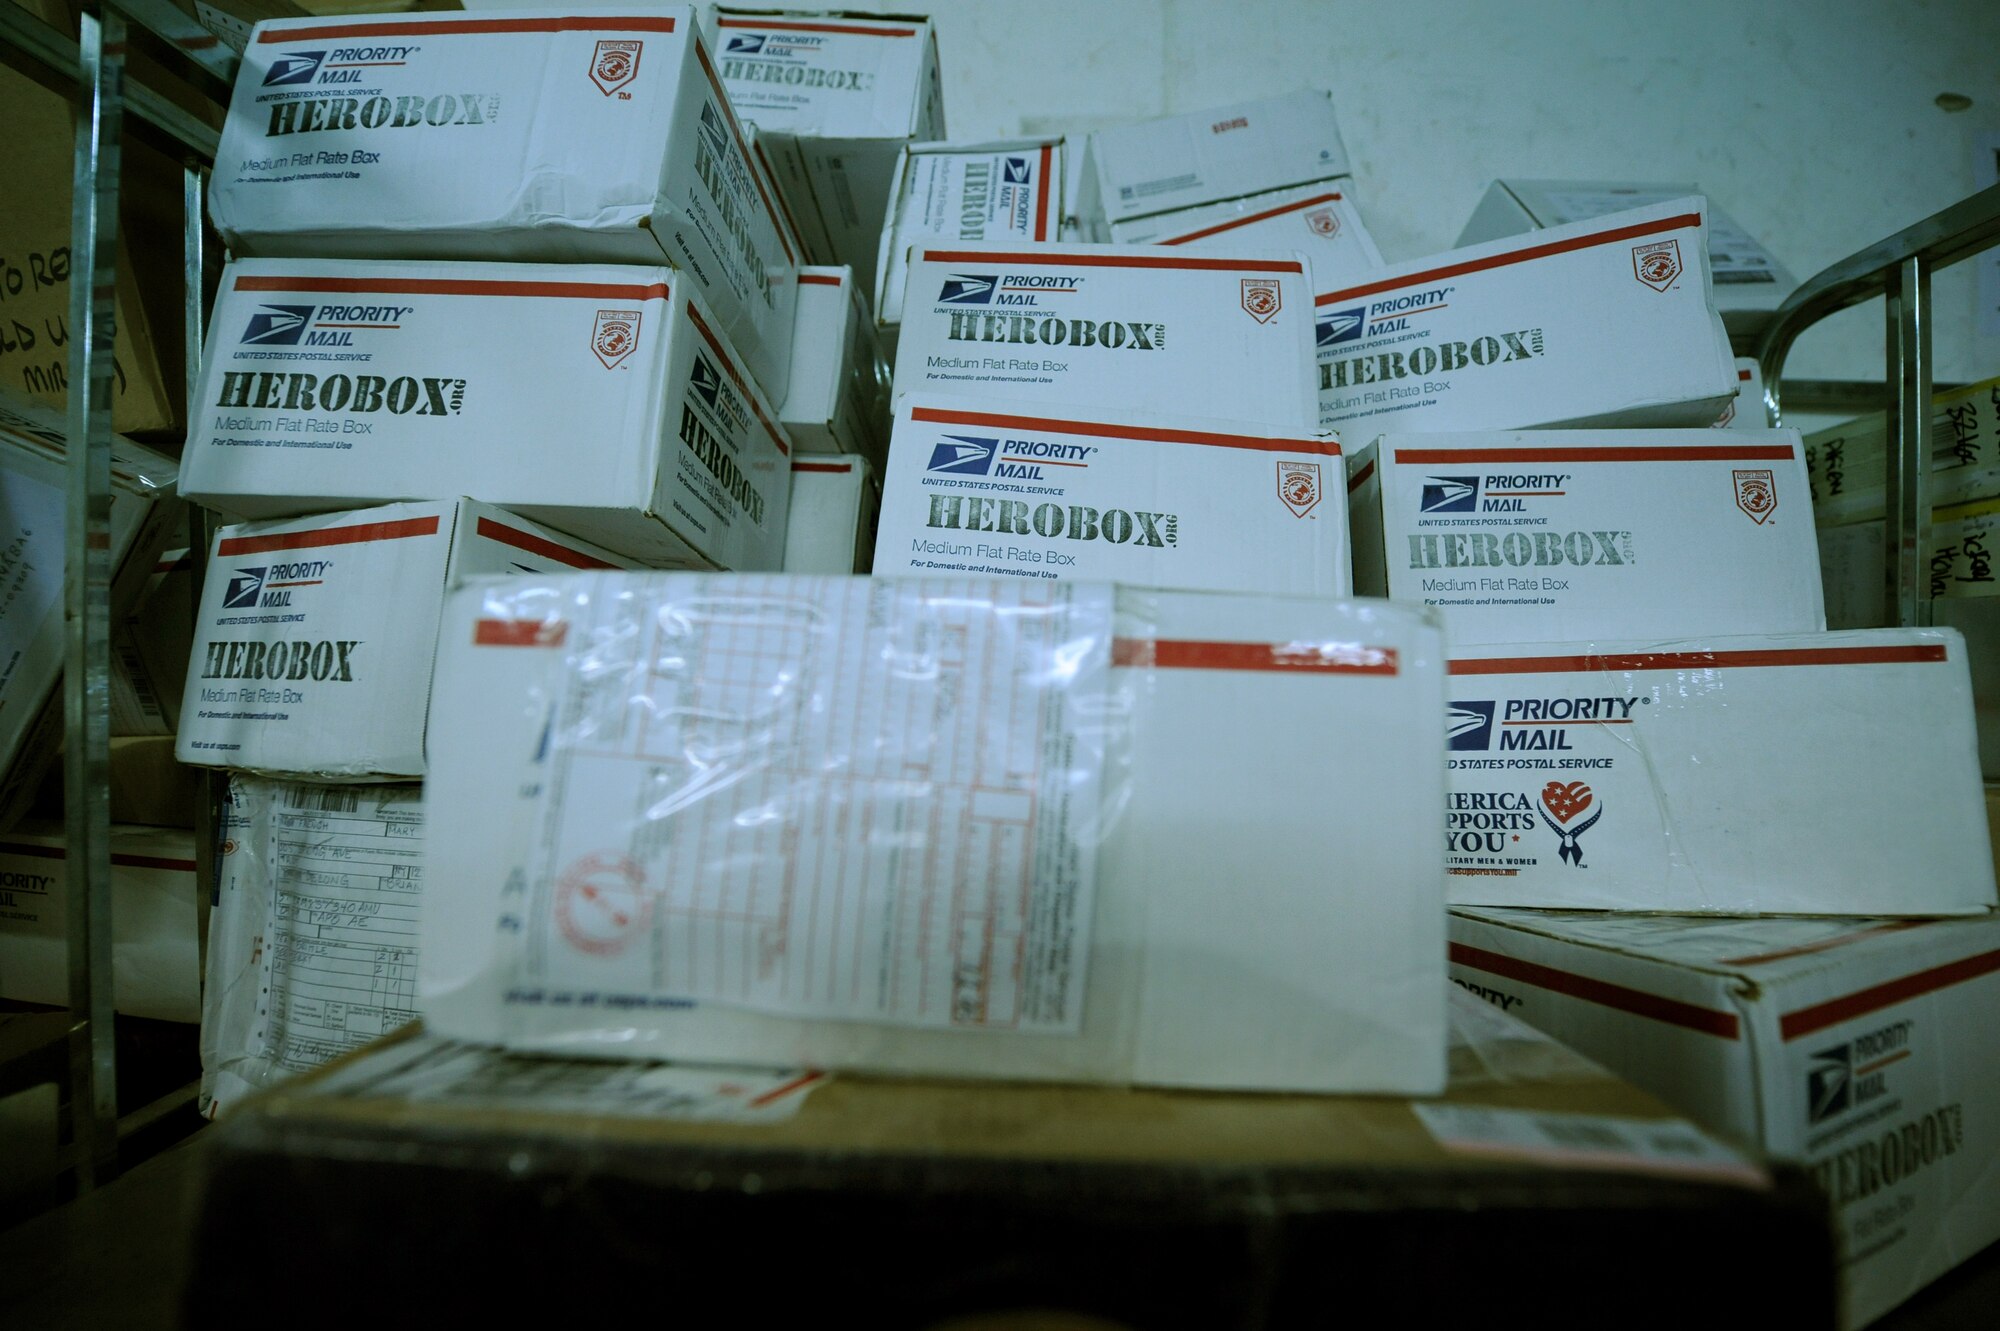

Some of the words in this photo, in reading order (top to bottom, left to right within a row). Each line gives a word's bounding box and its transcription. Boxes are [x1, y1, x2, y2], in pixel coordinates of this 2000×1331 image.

[769, 34, 823, 45] PRIORITY
[329, 46, 416, 61] PRIORITY
[763, 48, 793, 56] MAIL
[318, 70, 362, 84] MAIL
[723, 61, 864, 91] HEROBOX
[314, 90, 346, 98] POSTAL
[346, 88, 383, 96] SERVICE
[265, 93, 486, 137] HEROBOX
[240, 157, 287, 172] Medium
[291, 154, 314, 168] Flat
[317, 151, 348, 166] Rate
[351, 150, 380, 164] Box
[345, 171, 360, 179] Use
[960, 162, 990, 240] HEROB
[1000, 185, 1012, 209] MAIL
[1016, 186, 1030, 232] PRIORITY
[675, 231, 685, 245] Visit
[692, 257, 710, 288] usps.com
[1002, 275, 1079, 288] PRIORITY
[996, 294, 1039, 306] MAIL
[1371, 287, 1449, 316] PRIORITY
[316, 305, 407, 322] PRIORITY
[933, 307, 965, 315] UNITED
[965, 308, 992, 316] STATES
[947, 313, 1154, 350] HEROBOX
[1368, 318, 1411, 336] MAIL
[304, 331, 354, 346] MAIL
[1154, 324, 1166, 350] .ORG
[1339, 344, 1366, 354] STATES
[1367, 338, 1398, 350] POSTAL
[1398, 329, 1431, 344] SERVICE
[1531, 327, 1544, 356] .ORG
[233, 351, 271, 360] UNITED
[270, 352, 300, 360] STATES
[334, 353, 373, 362] SERVICE
[927, 356, 979, 369] Medium
[982, 357, 1005, 370] Flat
[1009, 359, 1039, 371] Rate
[1042, 361, 1068, 372] Box
[1319, 330, 1532, 390] HEROBOX
[991, 375, 1038, 383] International
[216, 371, 453, 416] HEROBOX
[449, 378, 467, 415] .ORG
[1319, 397, 1361, 413] edium
[1364, 391, 1387, 406] Flat
[1390, 385, 1420, 401] Rate
[1424, 381, 1451, 395] Box
[716, 402, 734, 434] MAIL
[1325, 411, 1358, 424] Domestic
[1359, 409, 1373, 418] and
[1374, 401, 1421, 416] International
[1422, 399, 1437, 408] Use
[214, 417, 272, 432] Medium
[275, 418, 301, 432] Flat
[305, 419, 339, 434] Rate
[342, 420, 373, 434] Box
[211, 438, 227, 446] For
[228, 439, 264, 447] Domestic
[265, 439, 280, 448] and
[281, 439, 334, 449] International
[336, 441, 352, 449] Use
[1002, 439, 1091, 461] PRIORITY
[679, 401, 764, 526] HEROBOX
[994, 463, 1044, 480] MAIL
[921, 477, 958, 488] UNITED
[957, 480, 991, 491] STATES
[990, 482, 1027, 493] POSTAL
[1026, 486, 1065, 496] SERVICE
[1485, 475, 1566, 488] PRIORITY
[1482, 499, 1527, 512] MAIL
[926, 494, 1166, 548] HEROBOX
[1418, 519, 1451, 527] UNITED
[1165, 514, 1178, 549] .ORG
[911, 538, 971, 555] Medium
[977, 544, 1003, 559] Flat
[1007, 547, 1042, 562] Rate
[1046, 551, 1076, 566] Box
[1407, 531, 1625, 570] HEROBOX
[268, 561, 329, 580] PRIORITY
[910, 559, 925, 567] For
[926, 560, 967, 571] Domestic
[968, 563, 985, 572] and
[986, 564, 1041, 578] International
[1041, 570, 1059, 579] Use
[1422, 578, 1477, 591] Medium
[1481, 578, 1503, 591] Flat
[1508, 578, 1538, 591] Rate
[1542, 578, 1570, 590] Box
[260, 591, 292, 608] MAIL
[201, 640, 360, 682] HEROBOX
[201, 688, 237, 702] Medium
[240, 688, 256, 703] Flat
[259, 688, 280, 703] Rate
[282, 689, 303, 704] Box
[1504, 697, 1638, 720] PRIORITY
[1499, 729, 1573, 750] MAIL
[1459, 759, 1504, 769] STATES
[1507, 759, 1557, 769] POSTAL
[1559, 758, 1614, 769] SERVICE
[1448, 793, 1534, 811] ERICA
[389, 824, 415, 836] MARY
[1448, 813, 1535, 830] PPORTS
[348, 917, 370, 927] AE
